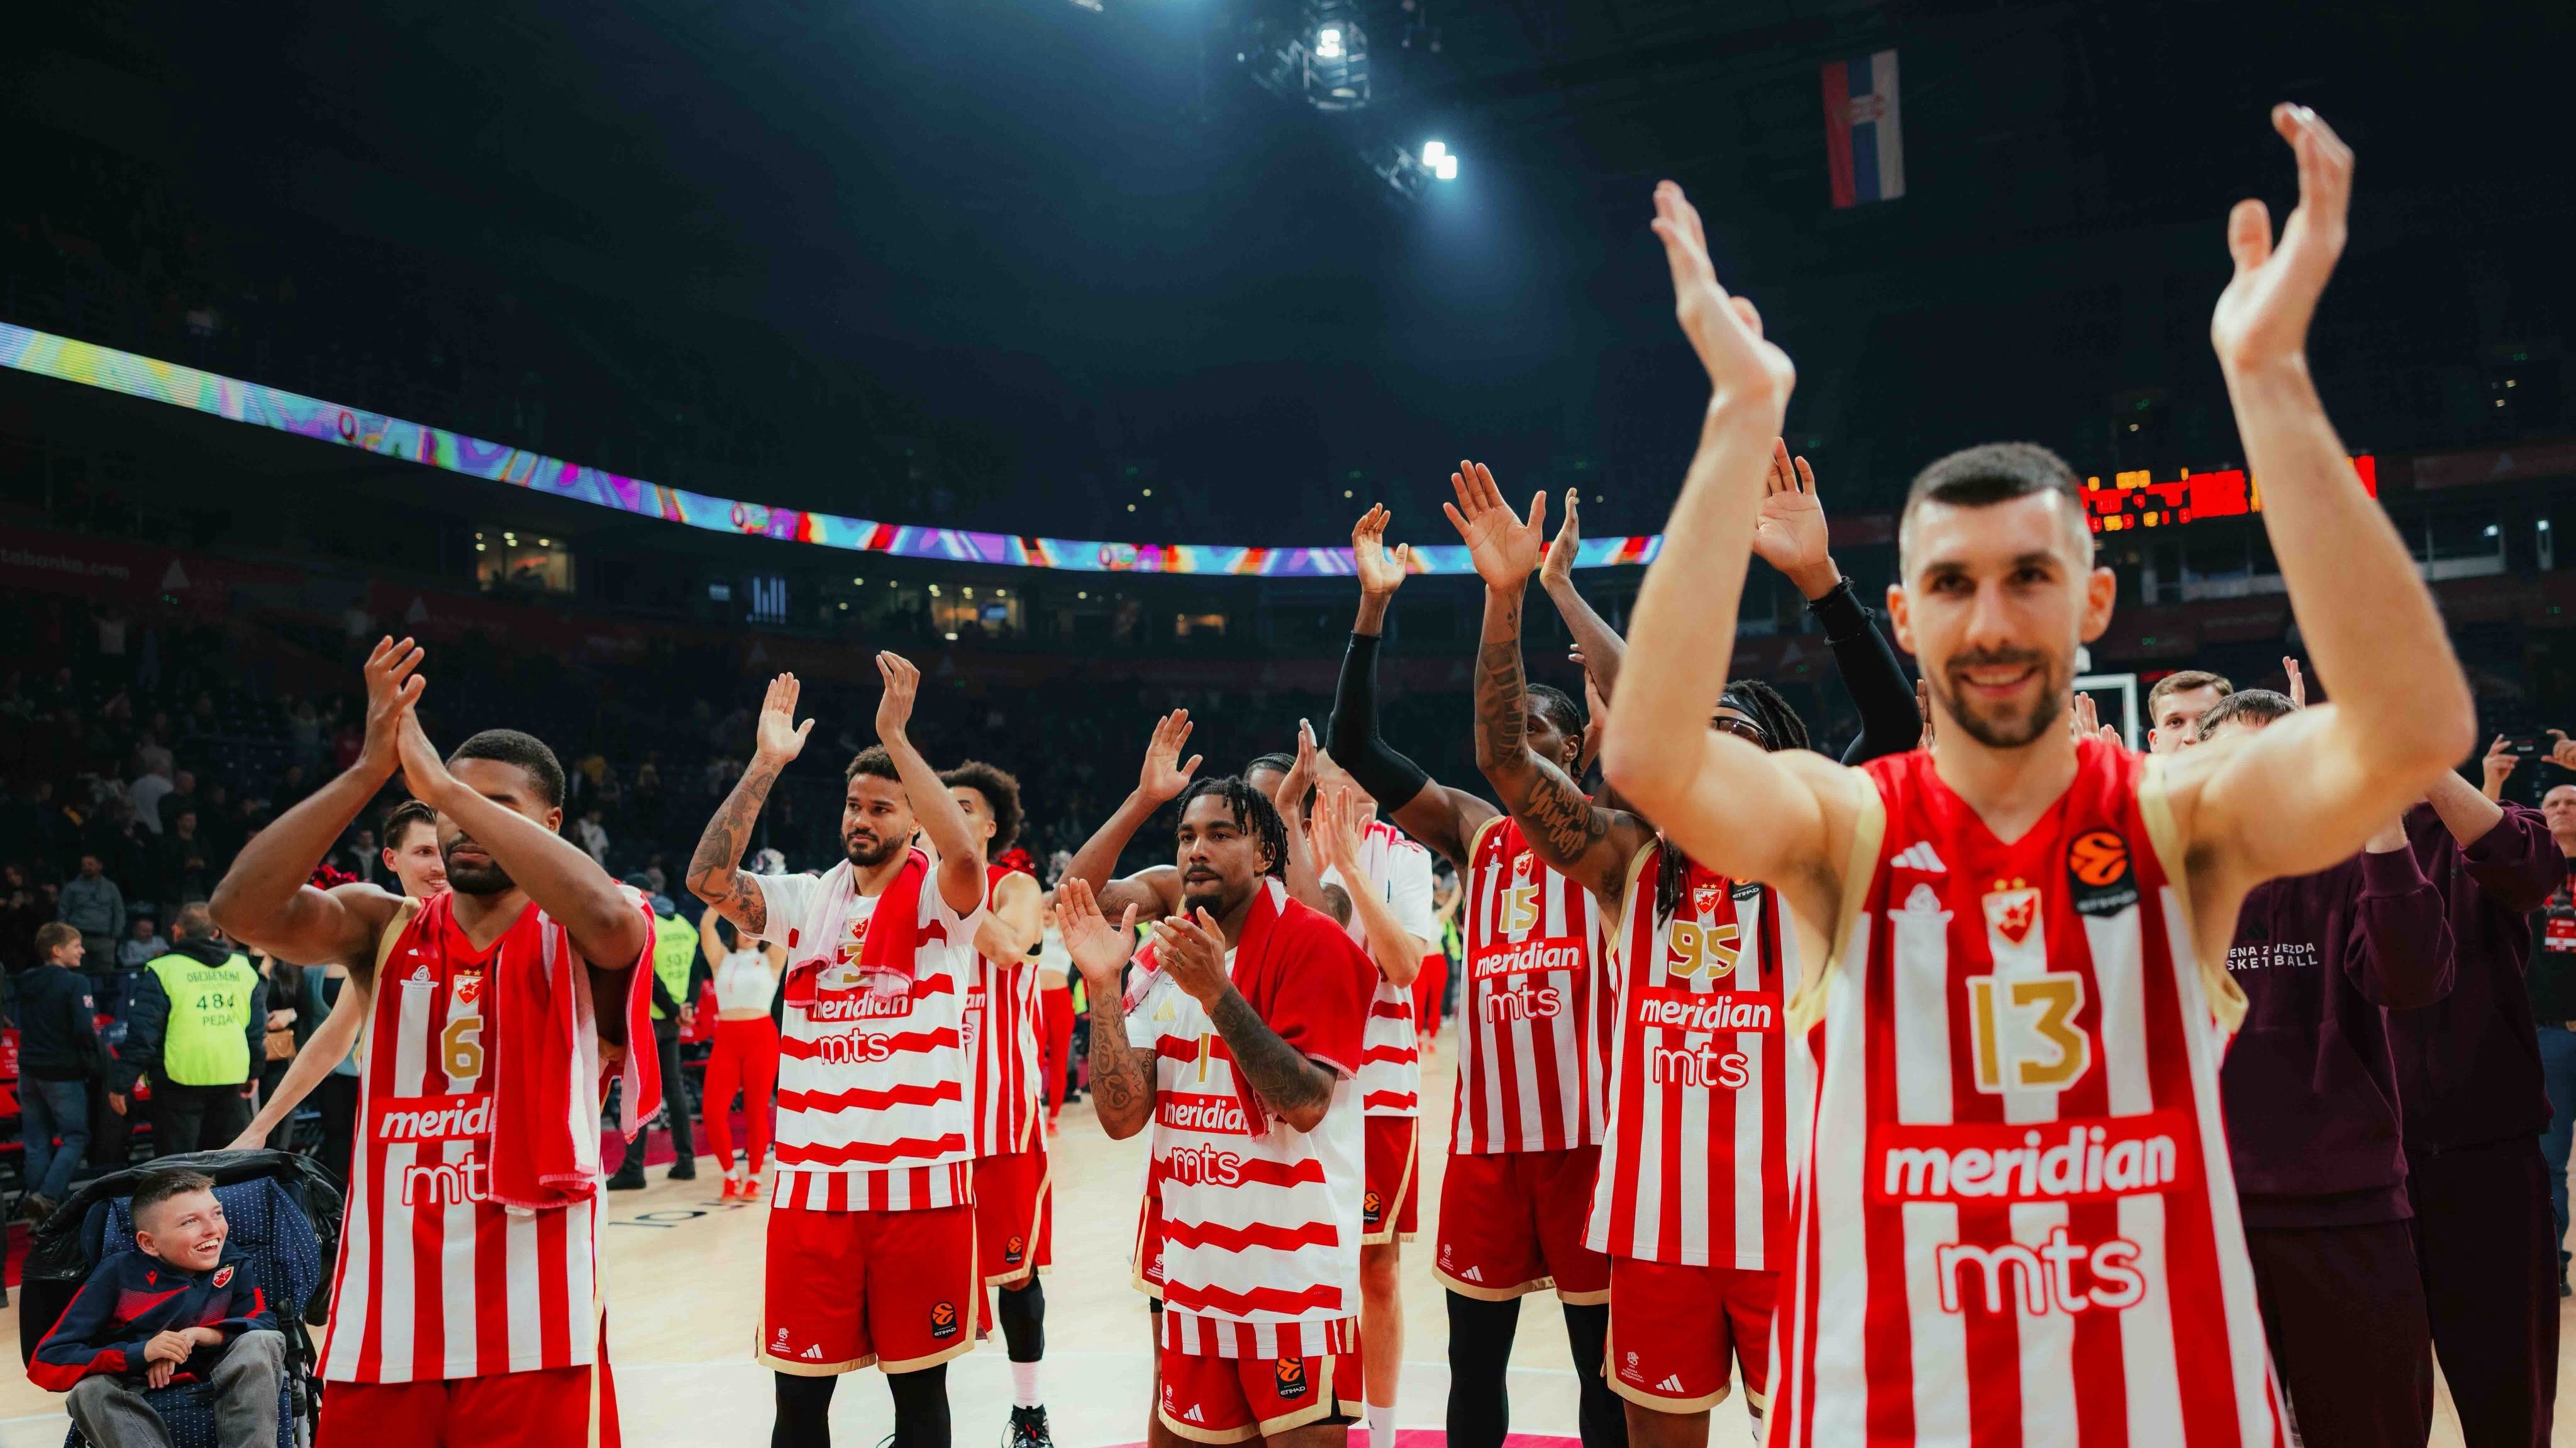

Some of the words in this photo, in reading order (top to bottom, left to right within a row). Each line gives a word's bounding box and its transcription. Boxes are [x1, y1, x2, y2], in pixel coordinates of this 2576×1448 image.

[1498, 883, 1539, 933] 15
[1733, 888, 1759, 898] ETIHAD
[1475, 941, 1580, 979] meridian
[1668, 919, 1741, 980] 95
[2226, 954, 2318, 970] SKETBALL
[2227, 946, 2257, 958] ENA
[1486, 982, 1562, 1024] mts
[1639, 995, 1771, 1030] meridian
[441, 1015, 484, 1081] 6
[819, 1027, 890, 1065] mts
[1967, 971, 2091, 1094] 13
[1652, 1042, 1750, 1090] mts
[379, 1097, 493, 1139] merid
[1164, 1098, 1248, 1130] meridia
[402, 1152, 489, 1206] mt
[1172, 1142, 1241, 1186] mts
[1885, 1124, 2176, 1197] meridian
[1936, 1226, 2146, 1315] mts
[934, 1327, 956, 1336] ETIHAD
[1280, 1386, 1306, 1395] ETIHAD
